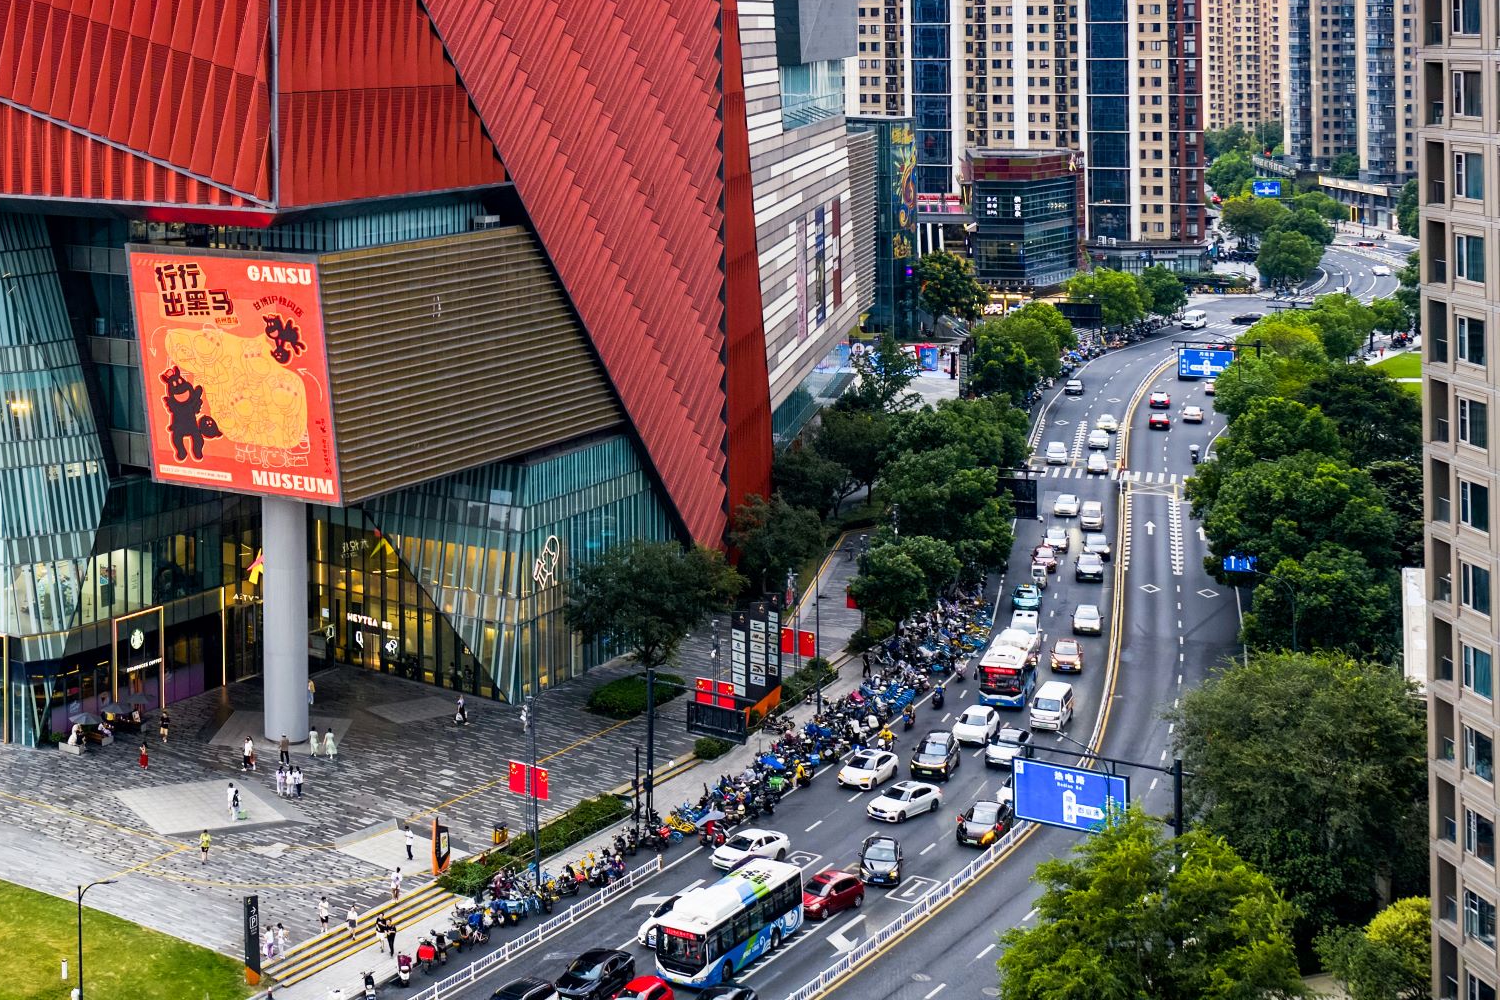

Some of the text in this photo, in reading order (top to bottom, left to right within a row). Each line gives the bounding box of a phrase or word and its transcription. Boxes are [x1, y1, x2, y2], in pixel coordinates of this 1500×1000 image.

[155, 264, 201, 292] 行行
[247, 265, 312, 285] GANSU
[162, 288, 234, 317] 出黑马
[251, 469, 334, 495] MUSEUM
[347, 612, 378, 628] HEYTEA
